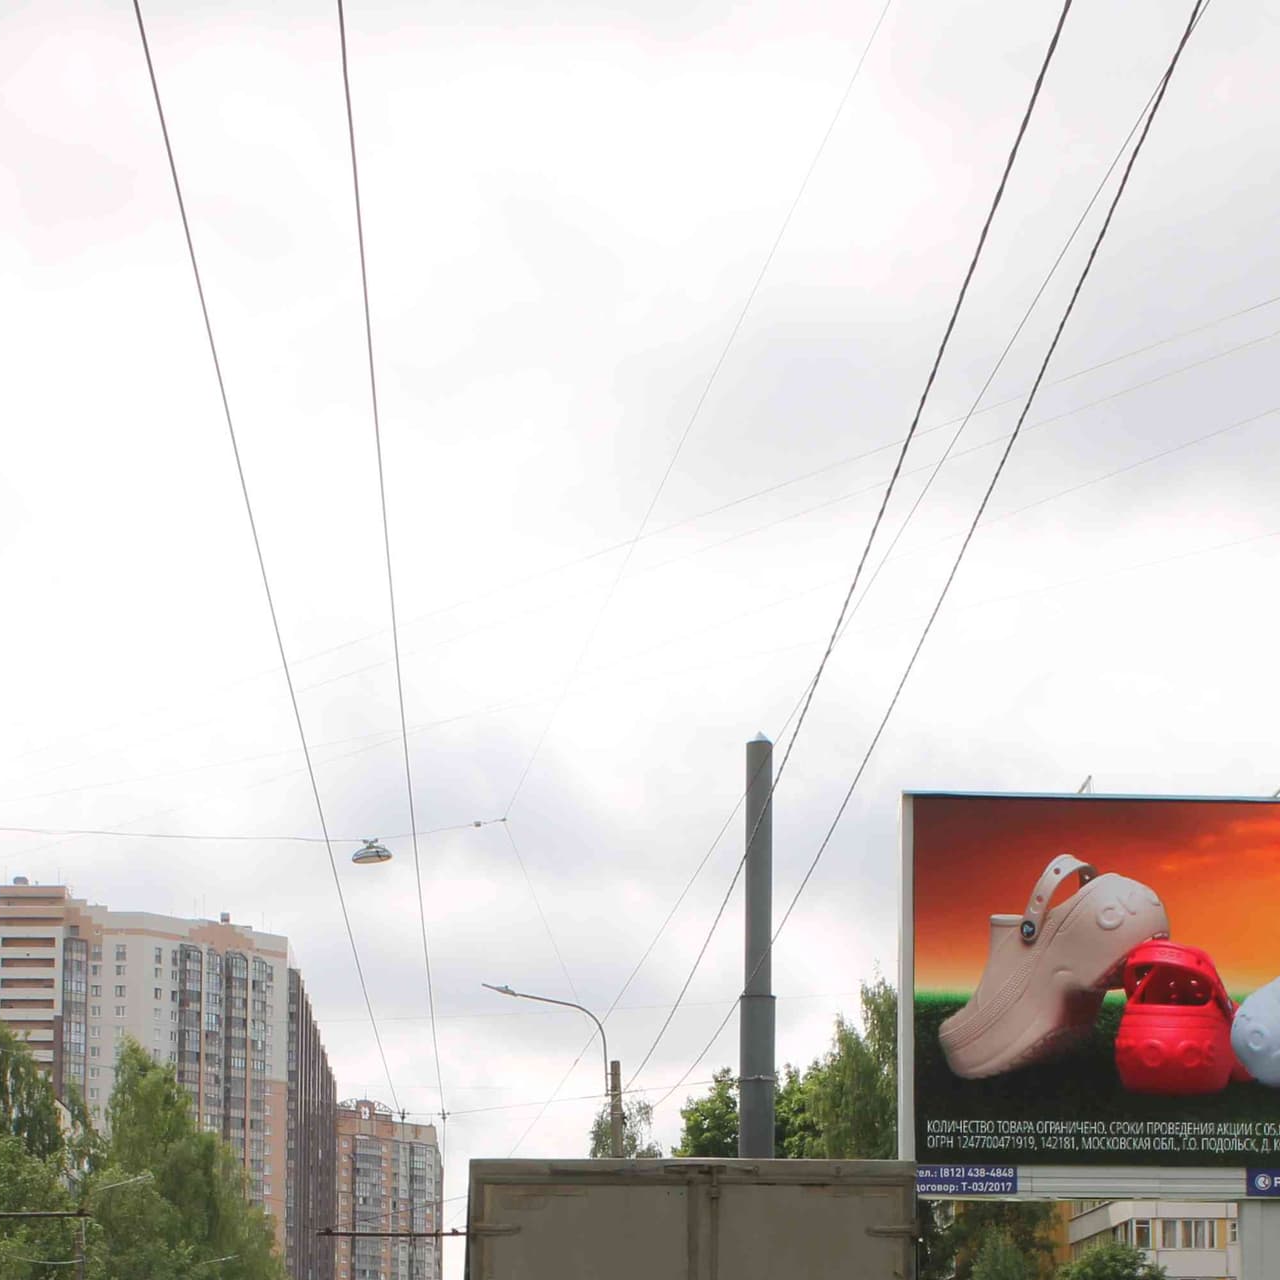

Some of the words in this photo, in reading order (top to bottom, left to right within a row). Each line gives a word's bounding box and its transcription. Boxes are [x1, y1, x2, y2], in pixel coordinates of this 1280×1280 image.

[927, 1120, 995, 1133] КОЛИЧЕСТВО
[997, 1121, 1034, 1134] ТОВАРА
[1036, 1122, 1108, 1135] ОГРАНИЧЕНО.
[1109, 1122, 1144, 1135] СРОКИ
[1146, 1123, 1215, 1137] ПРОВЕДЕНИЯ
[1217, 1123, 1253, 1137] АКЦИИ
[927, 1136, 954, 1149] ОГРН
[1082, 1138, 1151, 1151] МОСКОВСКАЯ
[940, 1167, 965, 1178] (812)
[968, 1168, 1014, 1177] 438-4848
